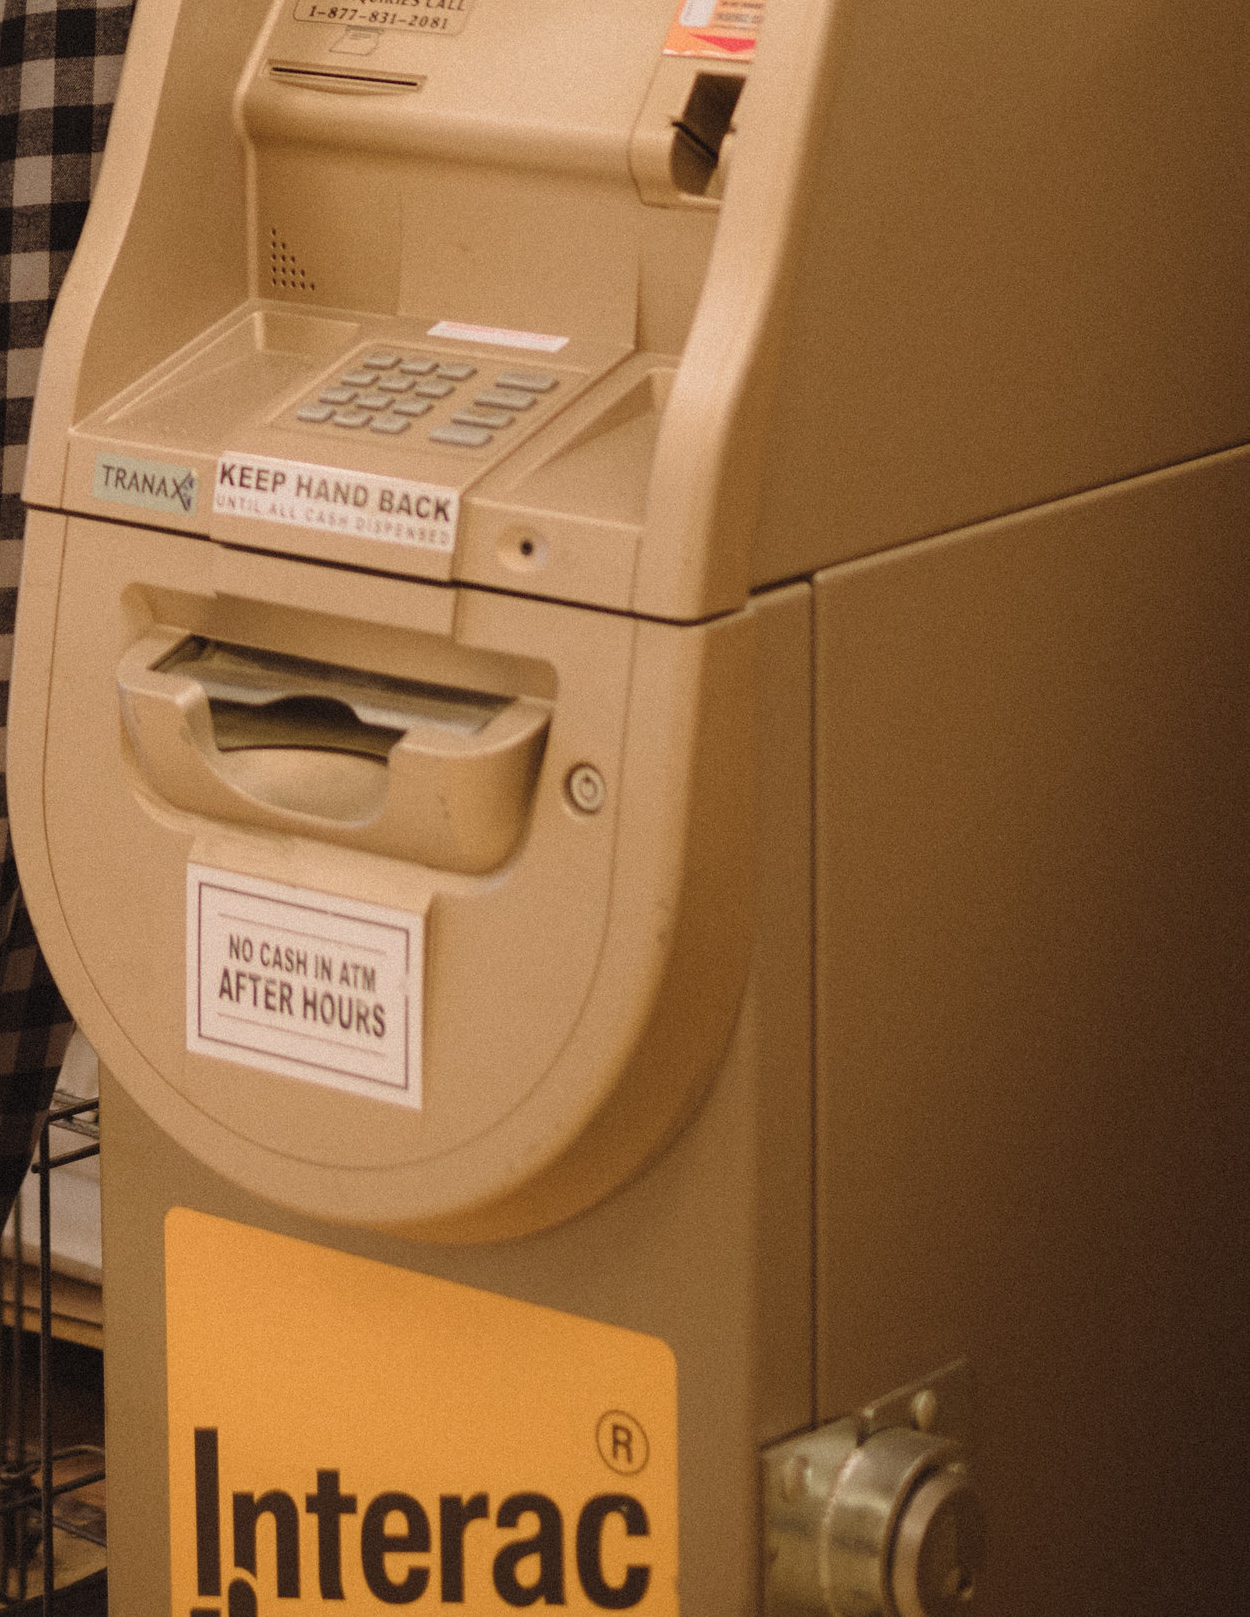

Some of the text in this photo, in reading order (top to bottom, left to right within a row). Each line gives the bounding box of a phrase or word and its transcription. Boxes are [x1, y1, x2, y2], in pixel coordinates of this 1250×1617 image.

[308, 4, 450, 31] 1-877-831-2081
[101, 463, 190, 512] TRANAX
[219, 463, 452, 524] KEEP HAND BACK
[229, 933, 377, 993] NO CASH IN ATM
[218, 966, 387, 1039] AFTER HOURS
[193, 1426, 651, 1611] Interac
